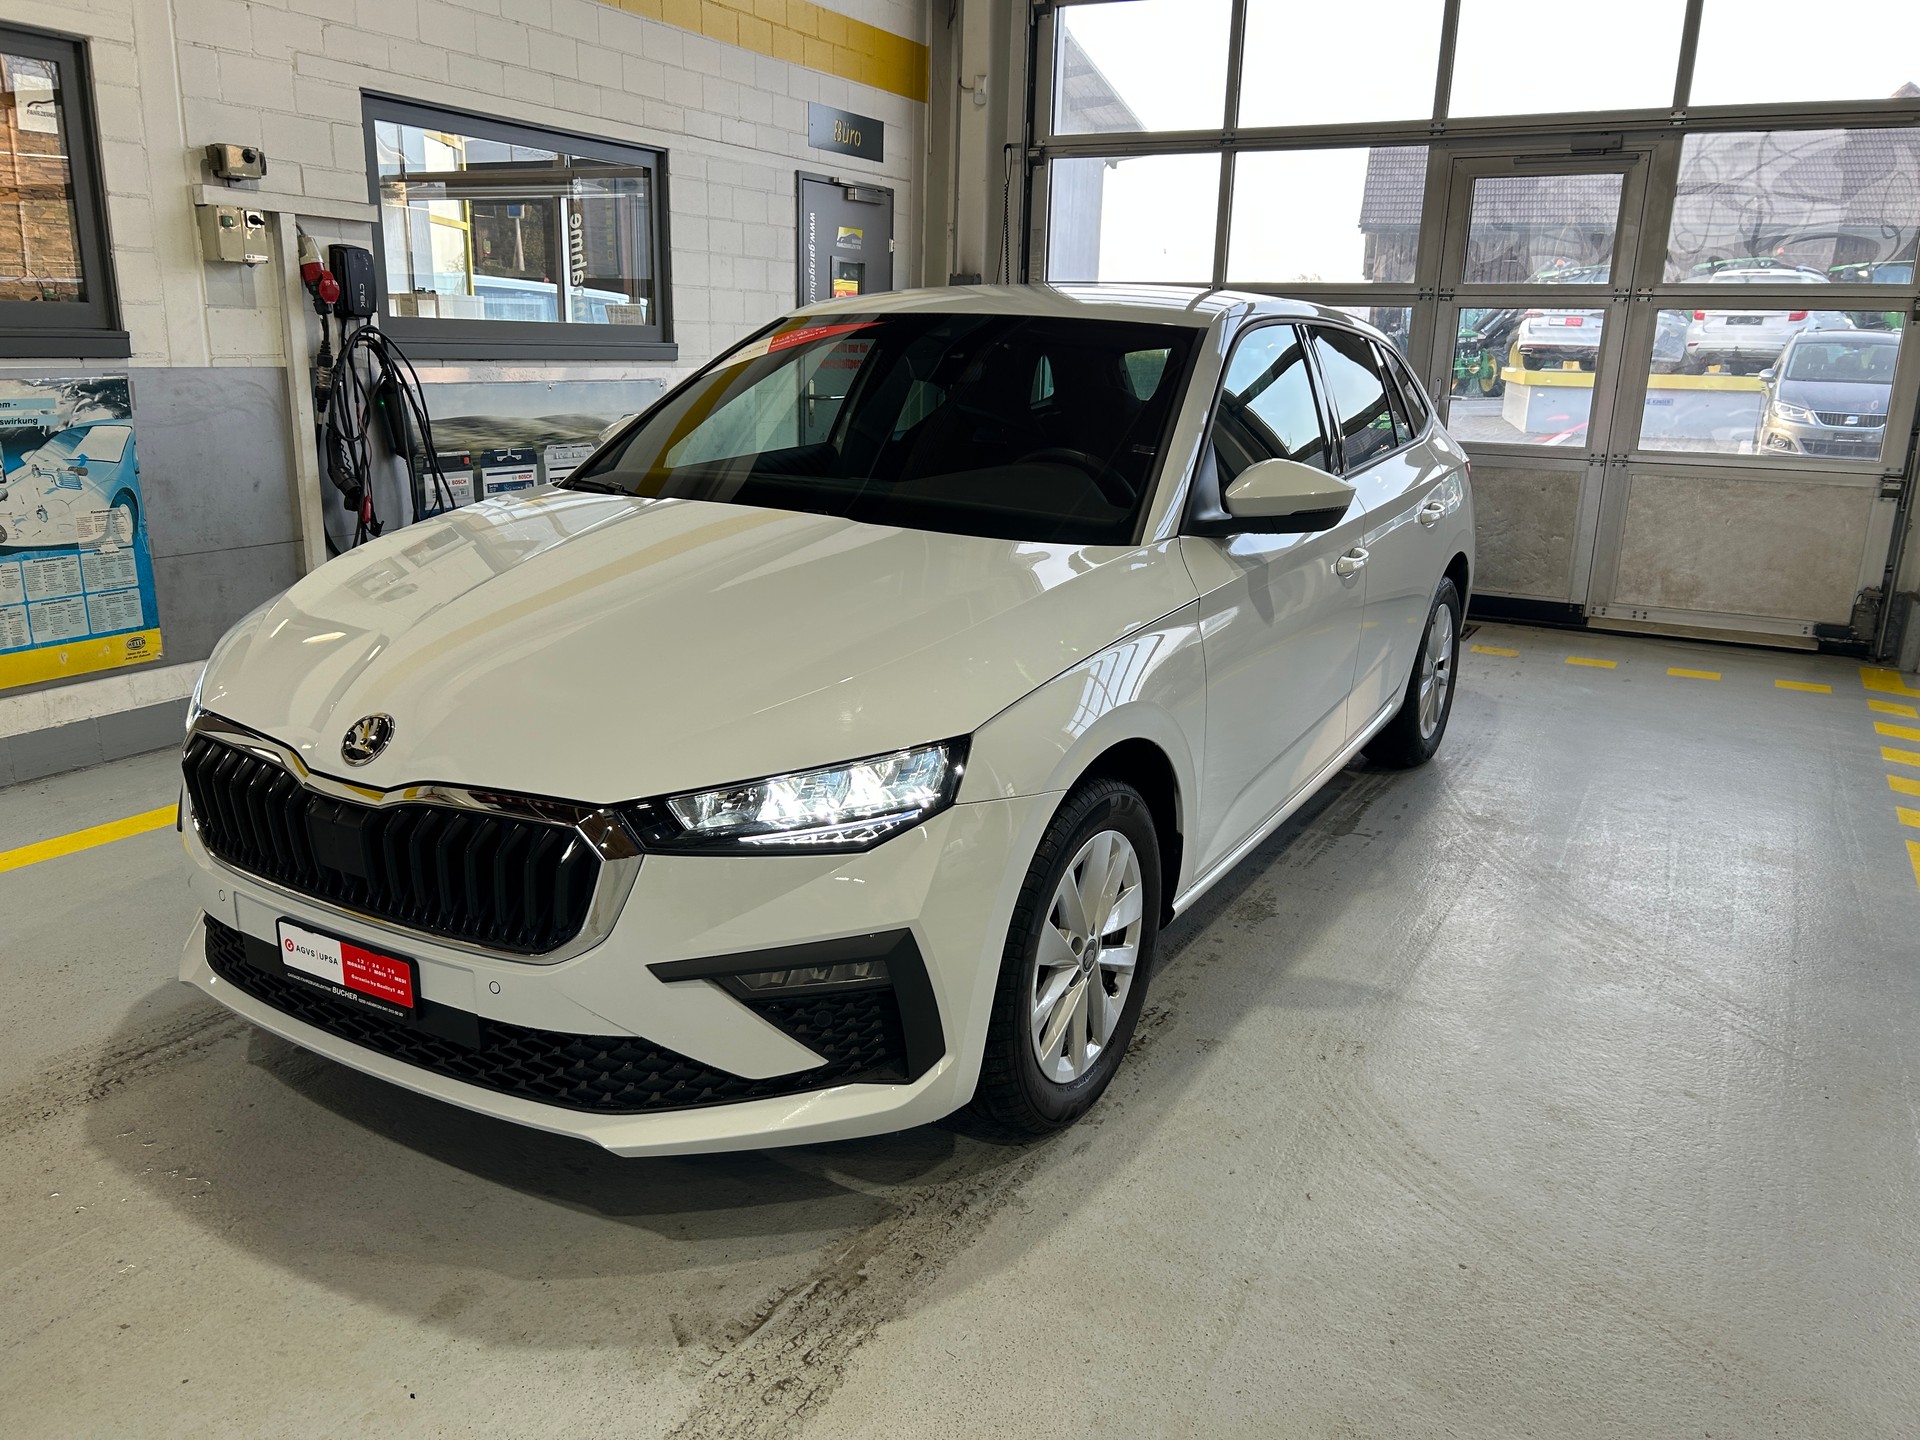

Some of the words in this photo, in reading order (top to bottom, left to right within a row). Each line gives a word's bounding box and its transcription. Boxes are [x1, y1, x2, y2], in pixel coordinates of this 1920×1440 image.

[833, 119, 862, 147] Büro
[359, 283, 367, 308] CTEK
[0, 417, 39, 426] swirkung
[296, 944, 315, 958] AGVS
[319, 952, 339, 966] UPSA
[332, 986, 358, 1001] BUCHER
